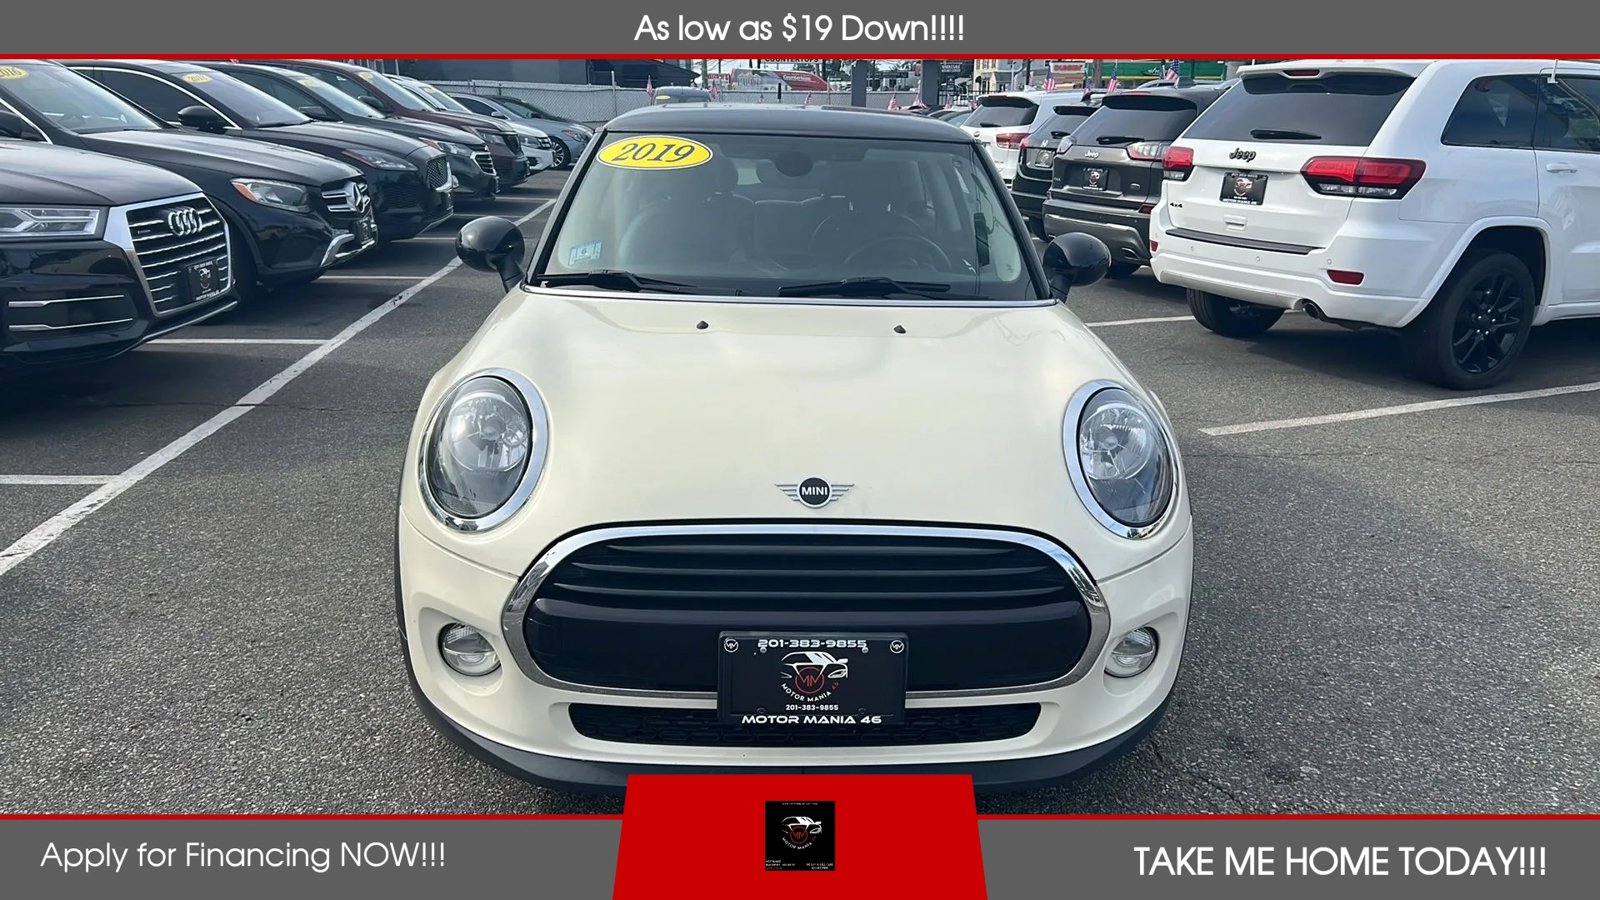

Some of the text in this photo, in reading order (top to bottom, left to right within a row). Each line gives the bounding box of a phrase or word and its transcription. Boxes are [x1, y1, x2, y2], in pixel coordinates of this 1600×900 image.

[611, 142, 695, 163] 2019
[1230, 148, 1257, 163] Jeep
[801, 486, 828, 496] MINI
[757, 639, 867, 649] 201-383-9855
[781, 682, 805, 702] MOTOR
[807, 691, 832, 702] MANIA
[742, 715, 882, 724] MOTOR MANIA 46
